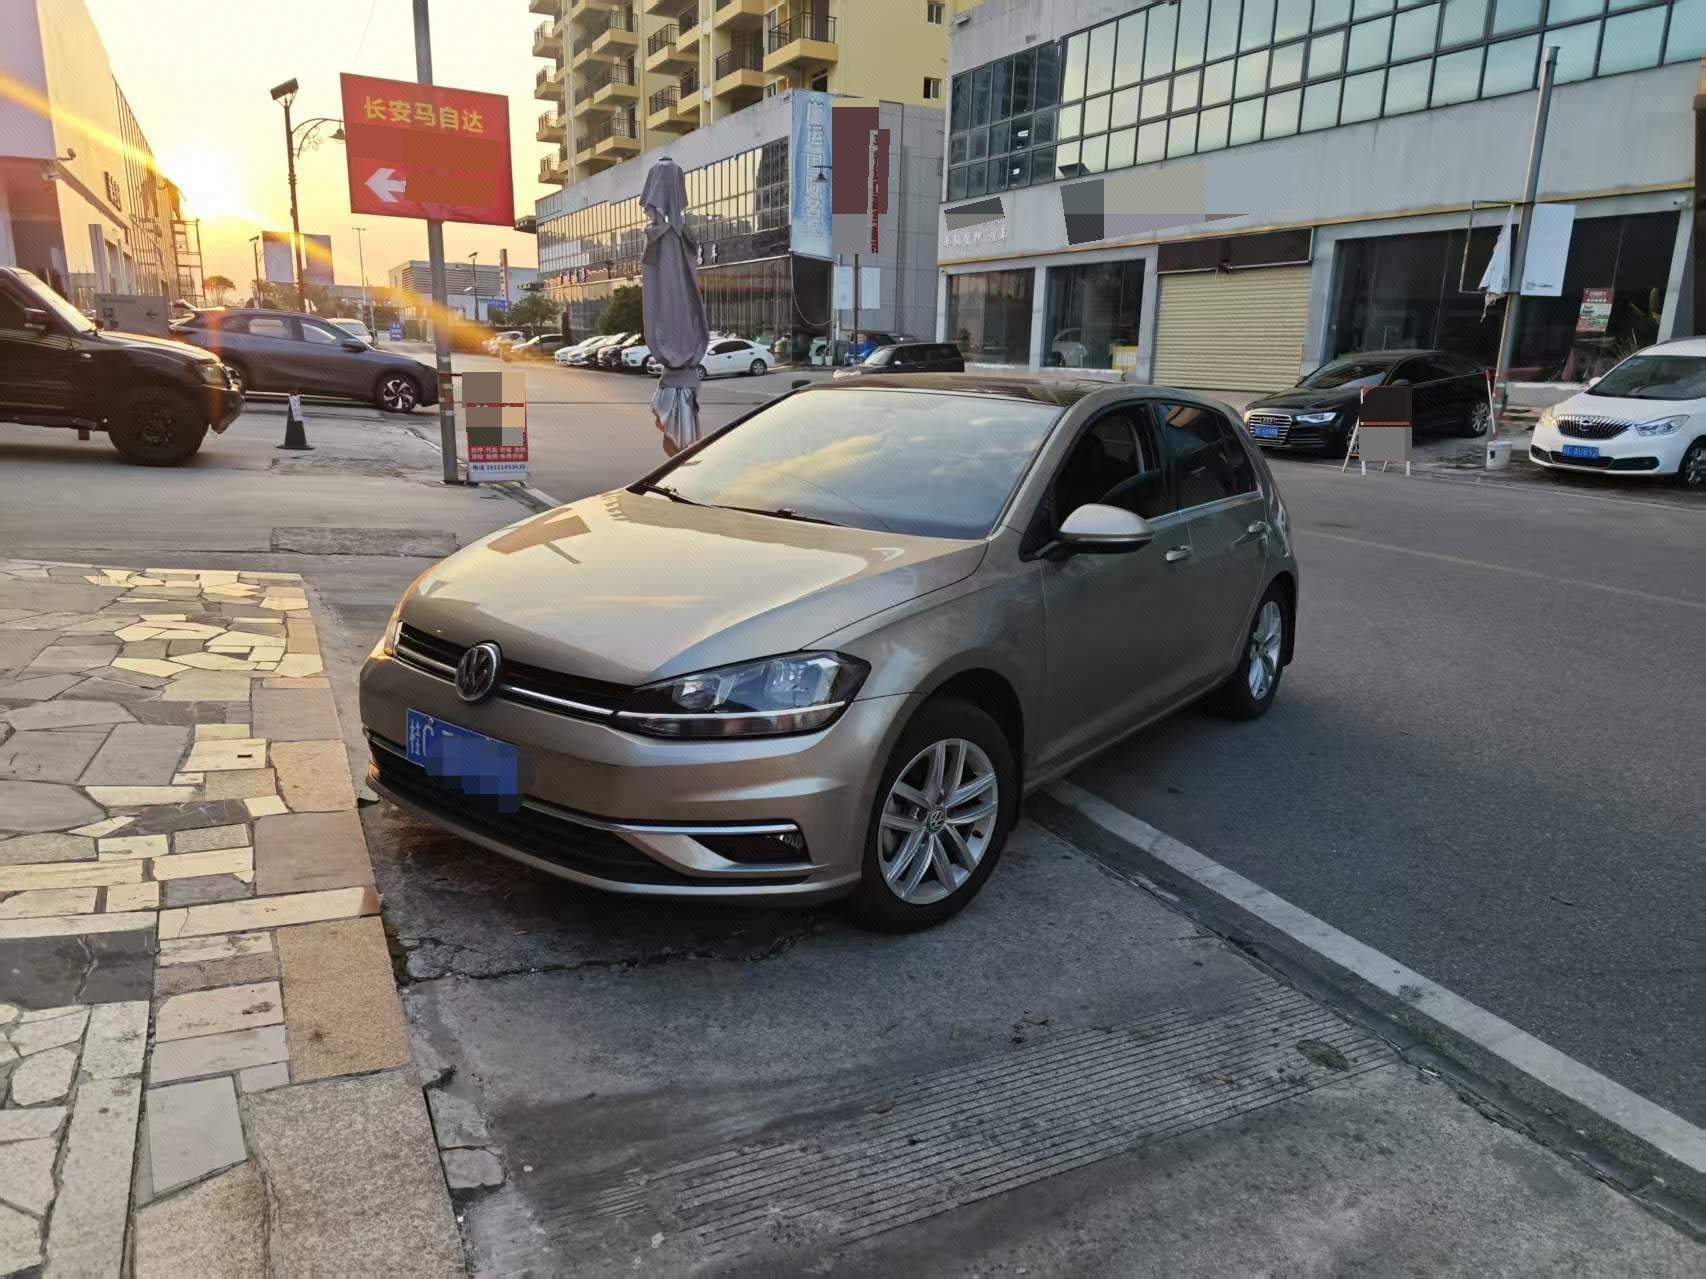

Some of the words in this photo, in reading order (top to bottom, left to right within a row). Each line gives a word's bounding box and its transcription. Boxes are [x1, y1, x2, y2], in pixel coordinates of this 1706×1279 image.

[363, 95, 484, 134] 长安马自达
